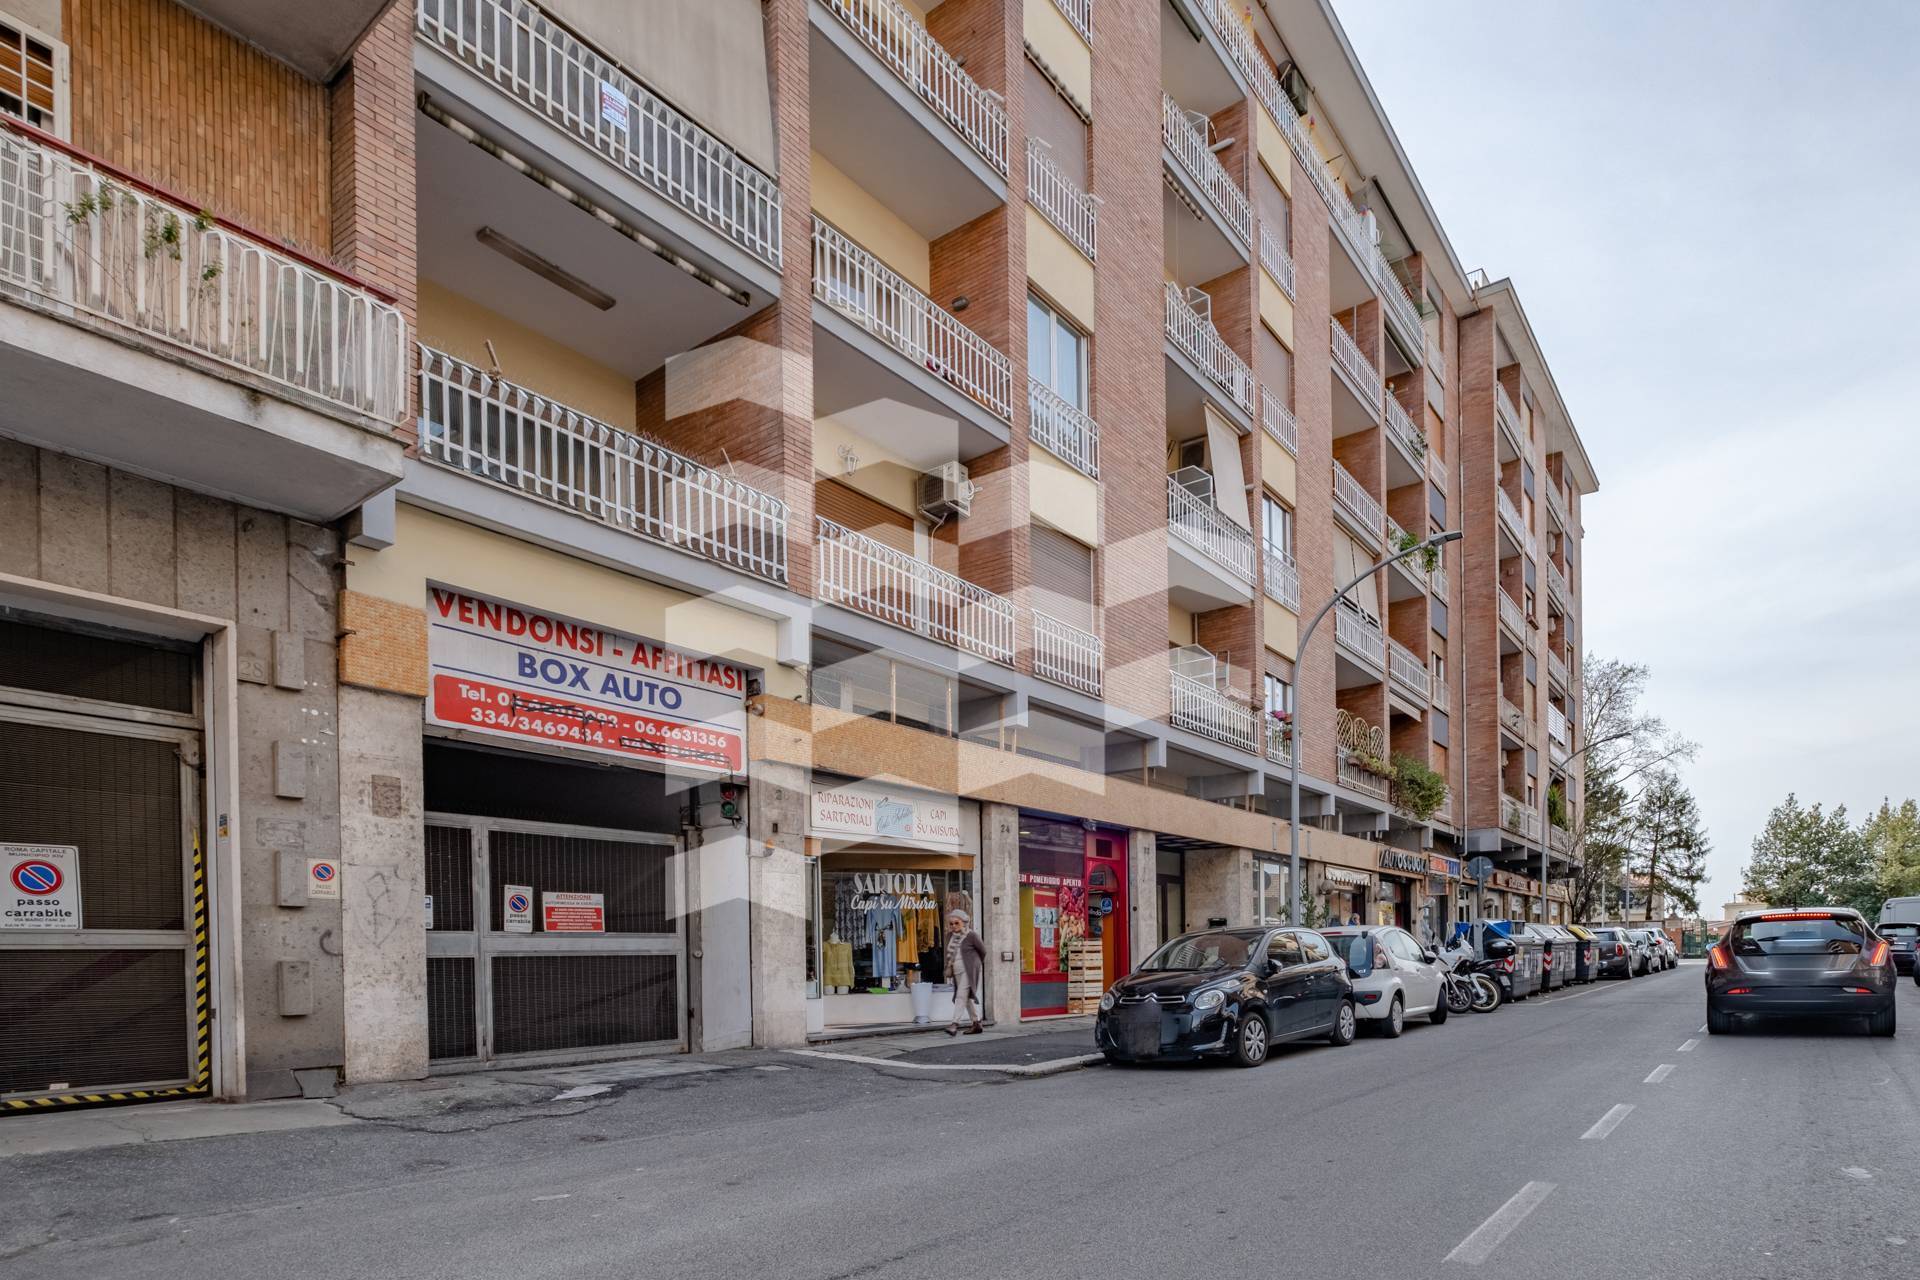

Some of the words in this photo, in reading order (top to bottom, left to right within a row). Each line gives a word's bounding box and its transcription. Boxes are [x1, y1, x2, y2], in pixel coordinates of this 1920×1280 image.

[431, 587, 604, 657] VENDONSI
[631, 642, 743, 692] AFFITTASI
[517, 651, 592, 692] BOX
[600, 672, 682, 710] AUTO
[458, 683, 492, 704] Tel.
[634, 720, 727, 749] 06.6631356
[470, 706, 604, 744] 334/3469434
[818, 791, 874, 811] RIPARAZIONI
[820, 809, 872, 827] SARTORIALI
[929, 808, 948, 821] CAPI
[916, 824, 928, 834] SU
[929, 825, 960, 838] MISURA
[1000, 824, 1010, 833] 24
[854, 872, 935, 895] SARTORIA
[1062, 877, 1082, 887] APERTO
[17, 899, 60, 907] passo
[850, 894, 879, 915] Capi
[879, 895, 895, 910] Su
[894, 894, 938, 910] Misura
[5, 908, 72, 918] carrabile
